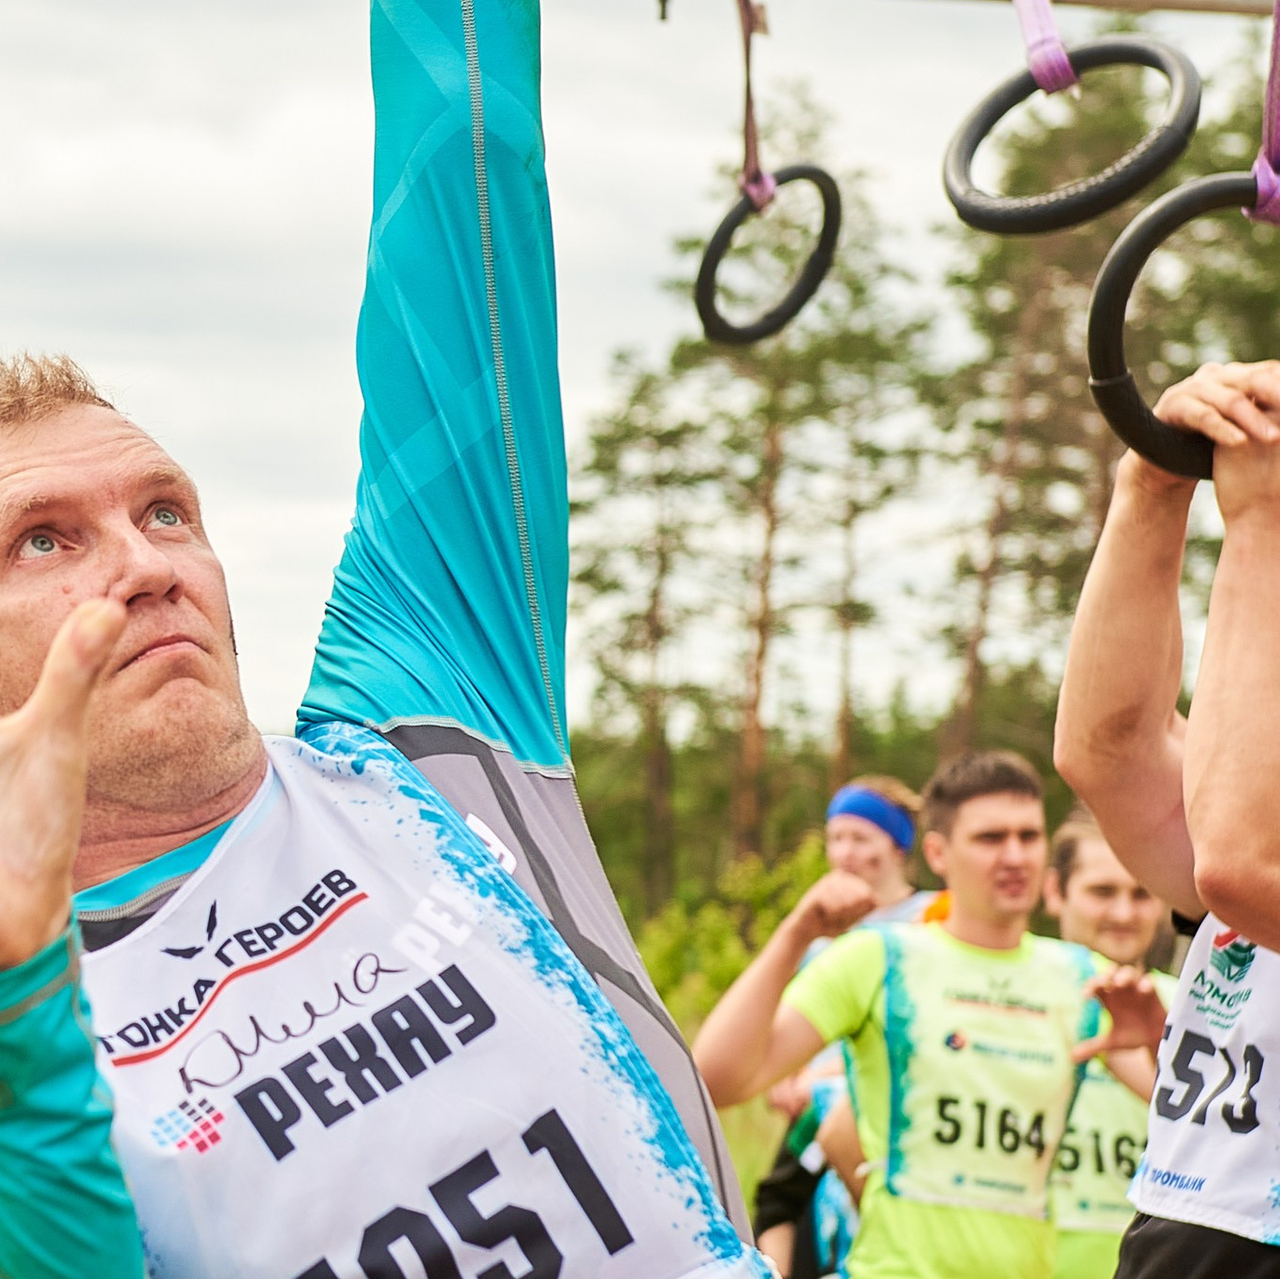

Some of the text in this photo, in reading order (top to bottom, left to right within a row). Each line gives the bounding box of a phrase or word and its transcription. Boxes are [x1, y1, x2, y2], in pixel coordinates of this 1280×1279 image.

[213, 868, 358, 968] ГЕРОЕВ
[233, 963, 497, 1162] РЕХАУ
[934, 1096, 1046, 1160] 5164
